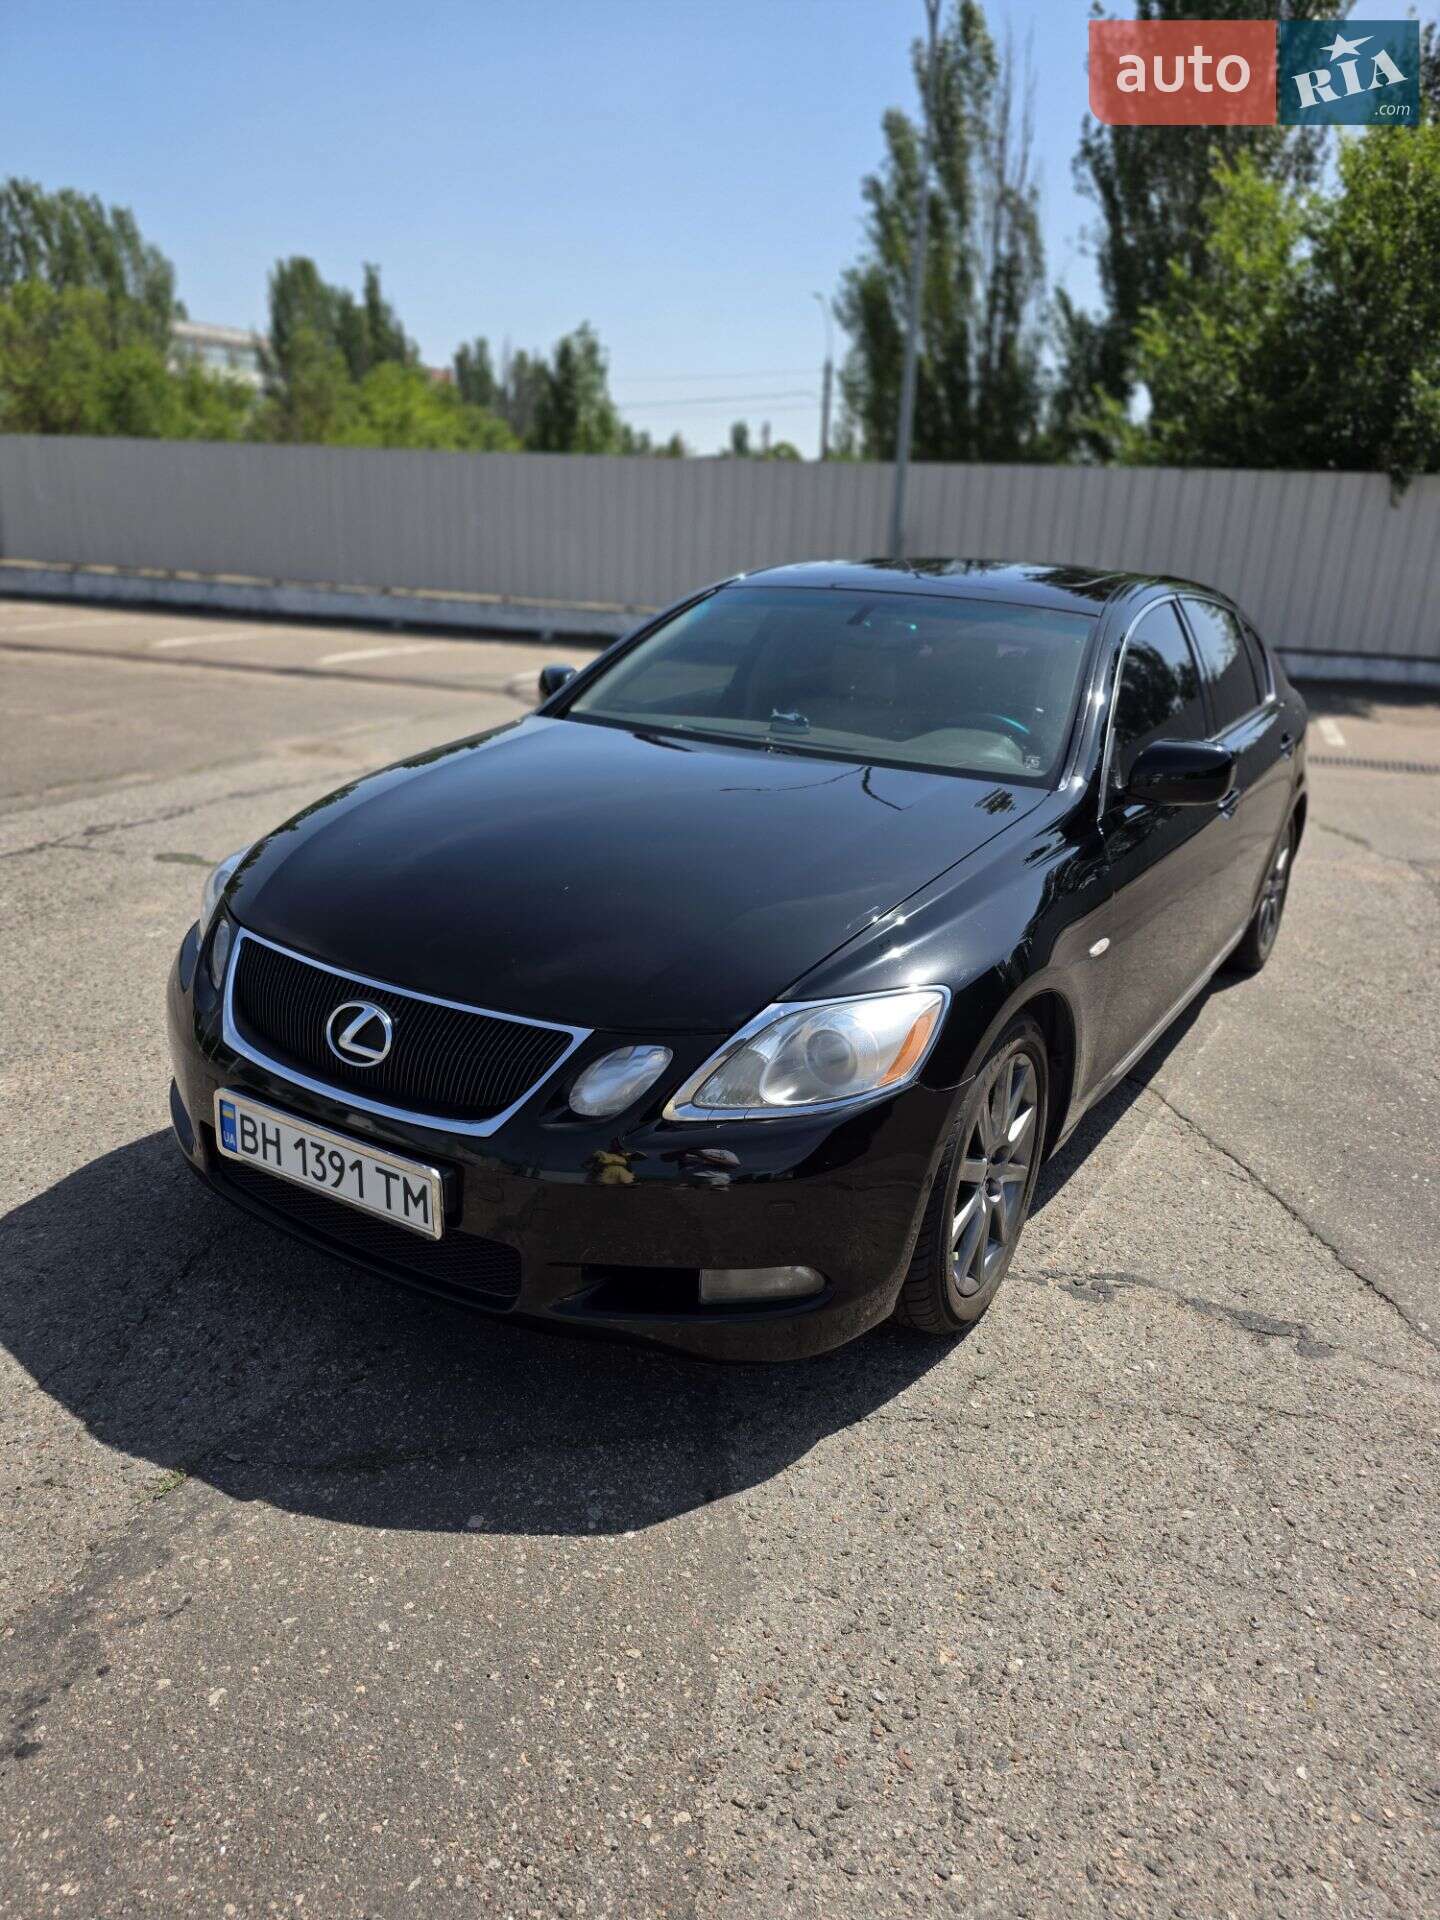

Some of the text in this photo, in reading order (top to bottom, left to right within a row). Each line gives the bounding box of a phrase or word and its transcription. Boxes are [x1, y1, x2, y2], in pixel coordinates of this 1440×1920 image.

[223, 1130, 236, 1147] UA
[293, 1137, 364, 1199] 1391
[375, 1166, 429, 1224] TM
